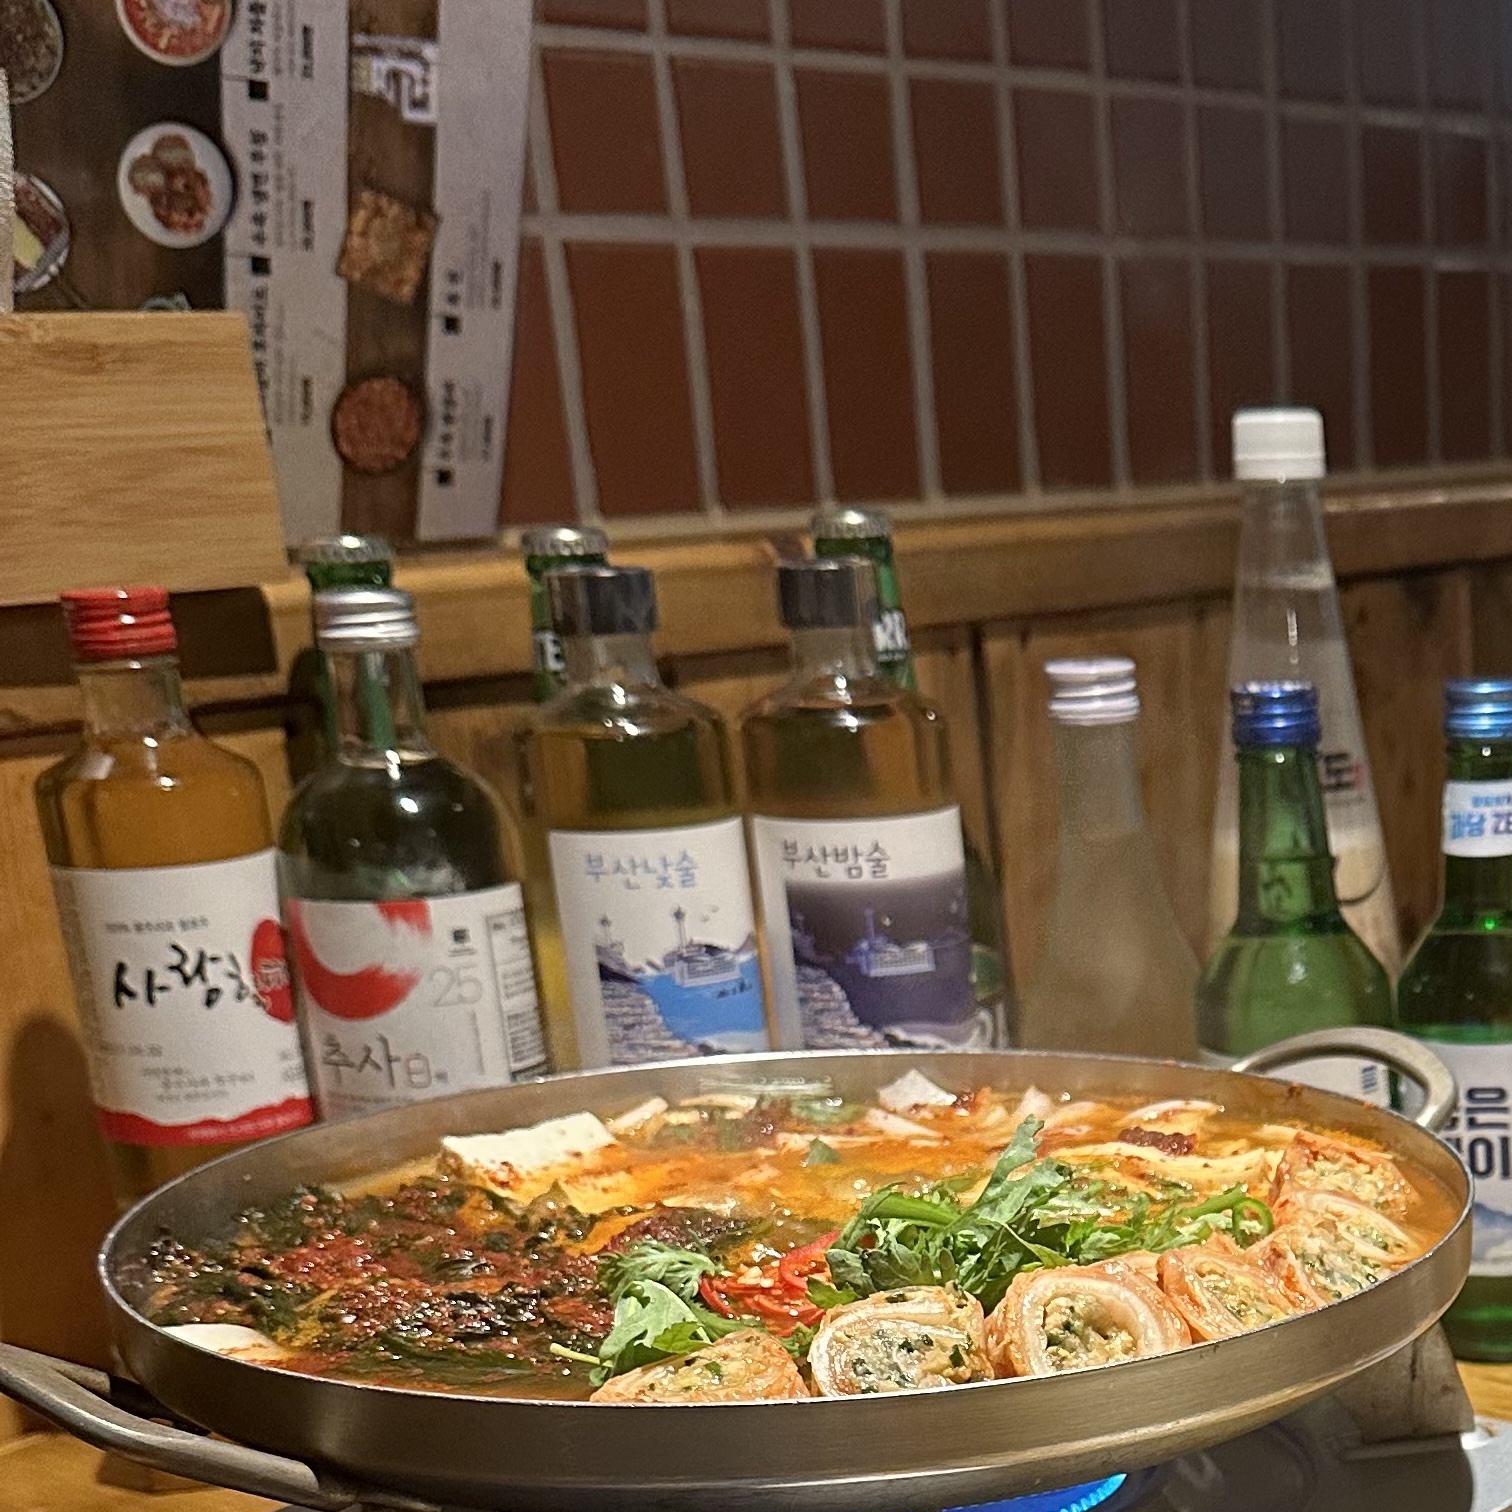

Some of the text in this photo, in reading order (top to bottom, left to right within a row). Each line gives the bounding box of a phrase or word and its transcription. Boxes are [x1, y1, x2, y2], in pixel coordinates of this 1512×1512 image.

[783, 839, 891, 880] 부산밤술
[429, 963, 484, 1008] 25
[1446, 1086, 1511, 1131] 은
